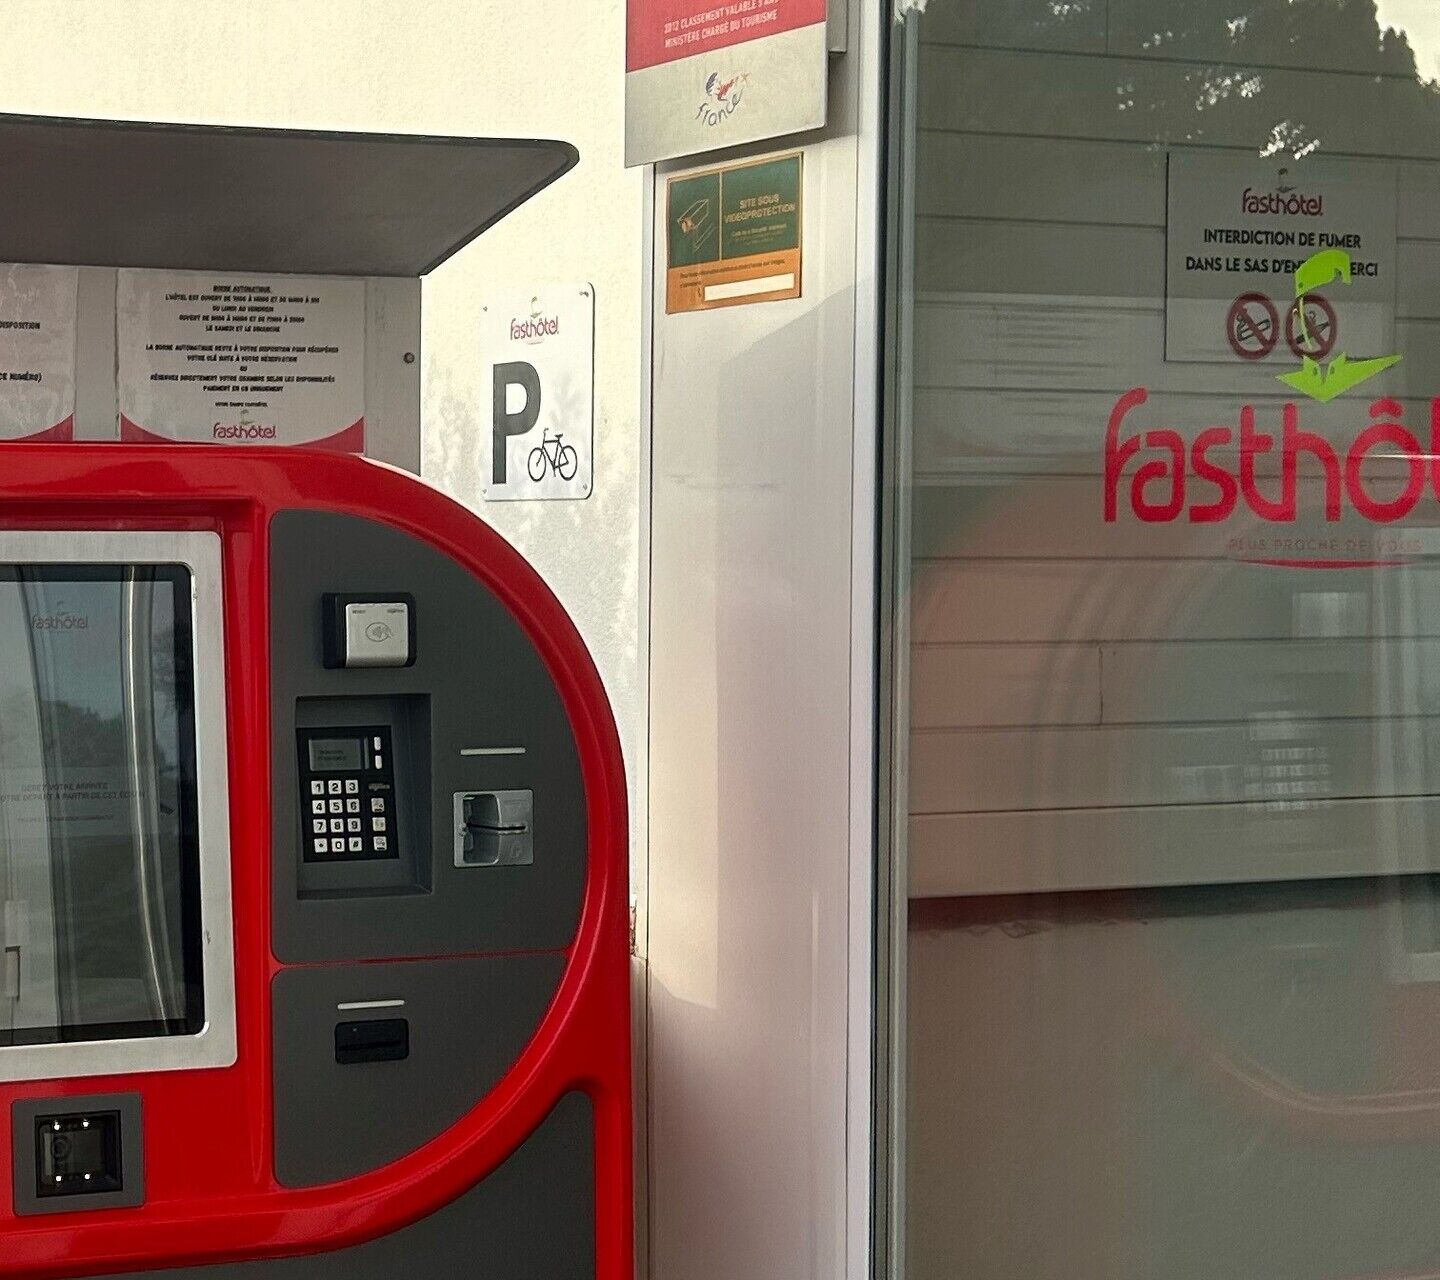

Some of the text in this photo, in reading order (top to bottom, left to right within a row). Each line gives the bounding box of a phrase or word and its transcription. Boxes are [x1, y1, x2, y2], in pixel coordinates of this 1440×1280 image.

[680, 7, 724, 30] CLASSEMENT
[730, 20, 741, 32] DU
[741, 9, 778, 28] TOURISME
[1242, 187, 1323, 216] fasthôtel
[1204, 228, 1361, 249] INTERDICTION DE FUMER
[1186, 256, 1222, 271] DANS
[1226, 258, 1240, 272] LE
[1244, 258, 1269, 273] SAS
[1340, 261, 1378, 277] ERCI
[213, 422, 276, 439] fasthôtel
[492, 361, 541, 485] P
